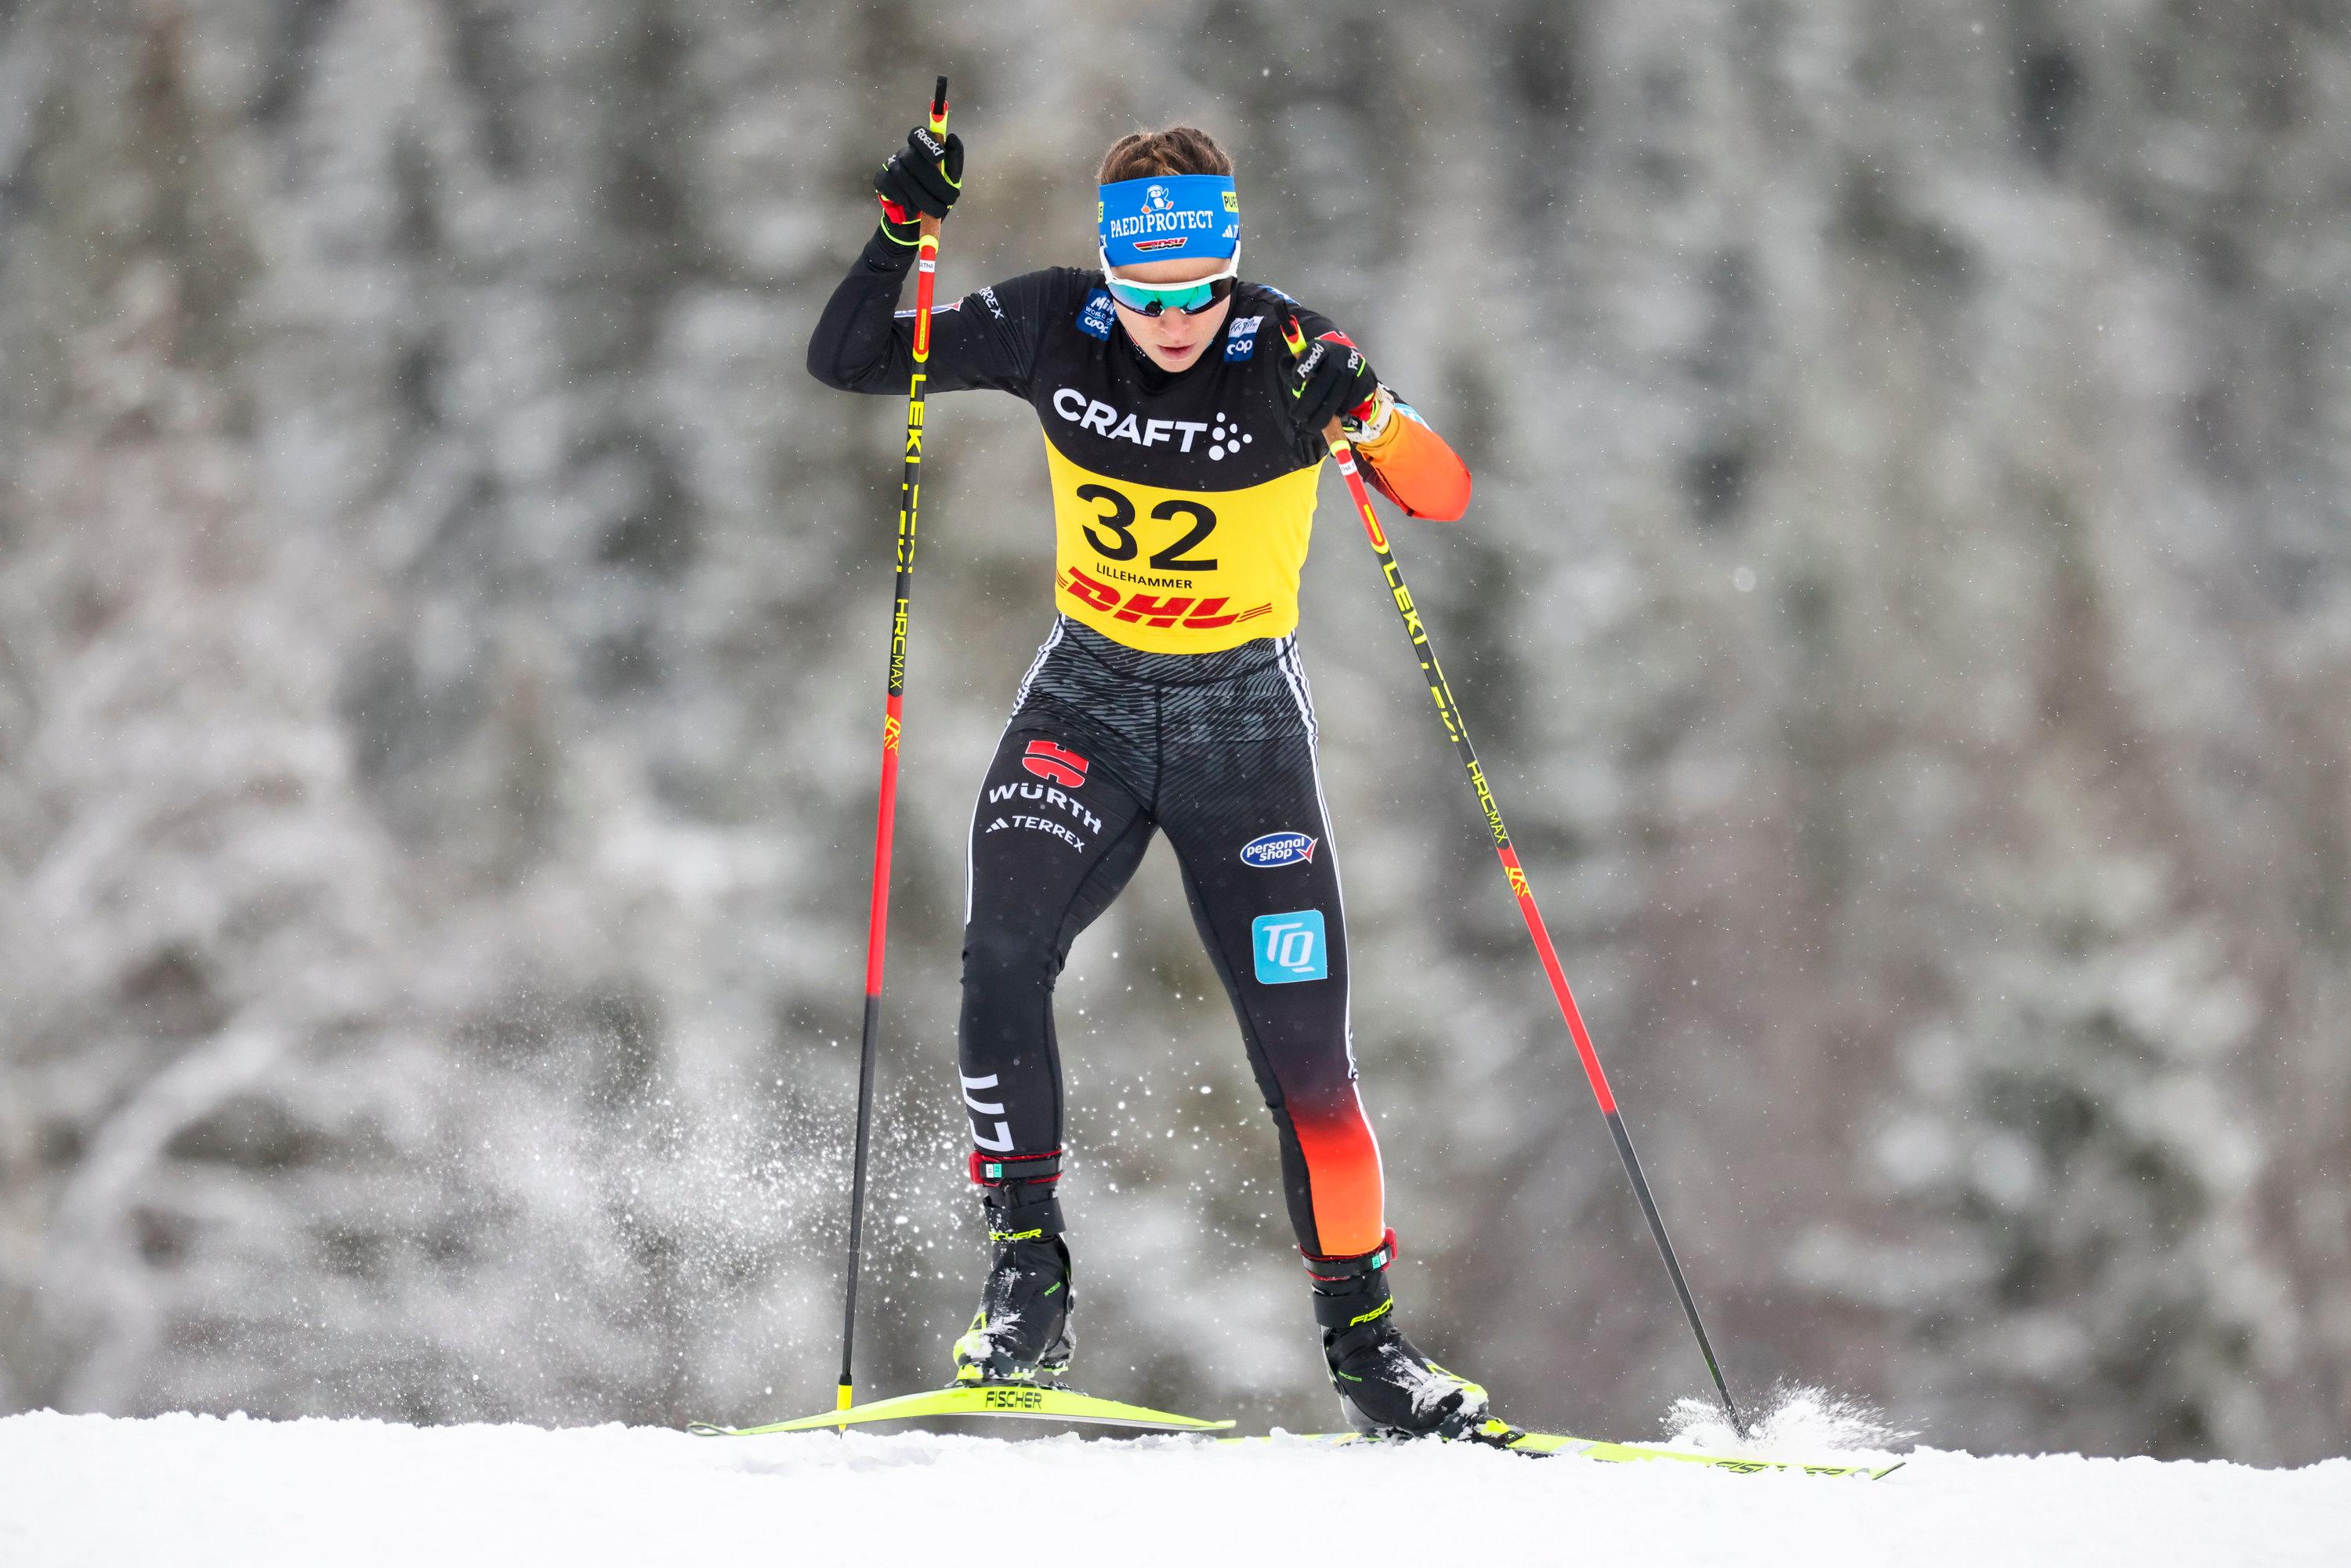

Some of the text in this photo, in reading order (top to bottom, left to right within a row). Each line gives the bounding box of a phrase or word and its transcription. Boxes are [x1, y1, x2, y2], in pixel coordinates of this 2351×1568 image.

[905, 374, 926, 464] LEKI
[1052, 388, 1208, 453] CRAFT
[1076, 483, 1218, 571] 32
[1067, 566, 1240, 629] DHL
[1096, 562, 1194, 589] LILLEHAMMER
[1382, 559, 1428, 645] LEKI
[989, 782, 1103, 835] WÜRTH
[1012, 815, 1085, 854] TERREX
[1247, 836, 1305, 858] personal
[1259, 847, 1293, 862] shop
[1262, 922, 1316, 973] TQ
[985, 1391, 1042, 1410] FISCHER
